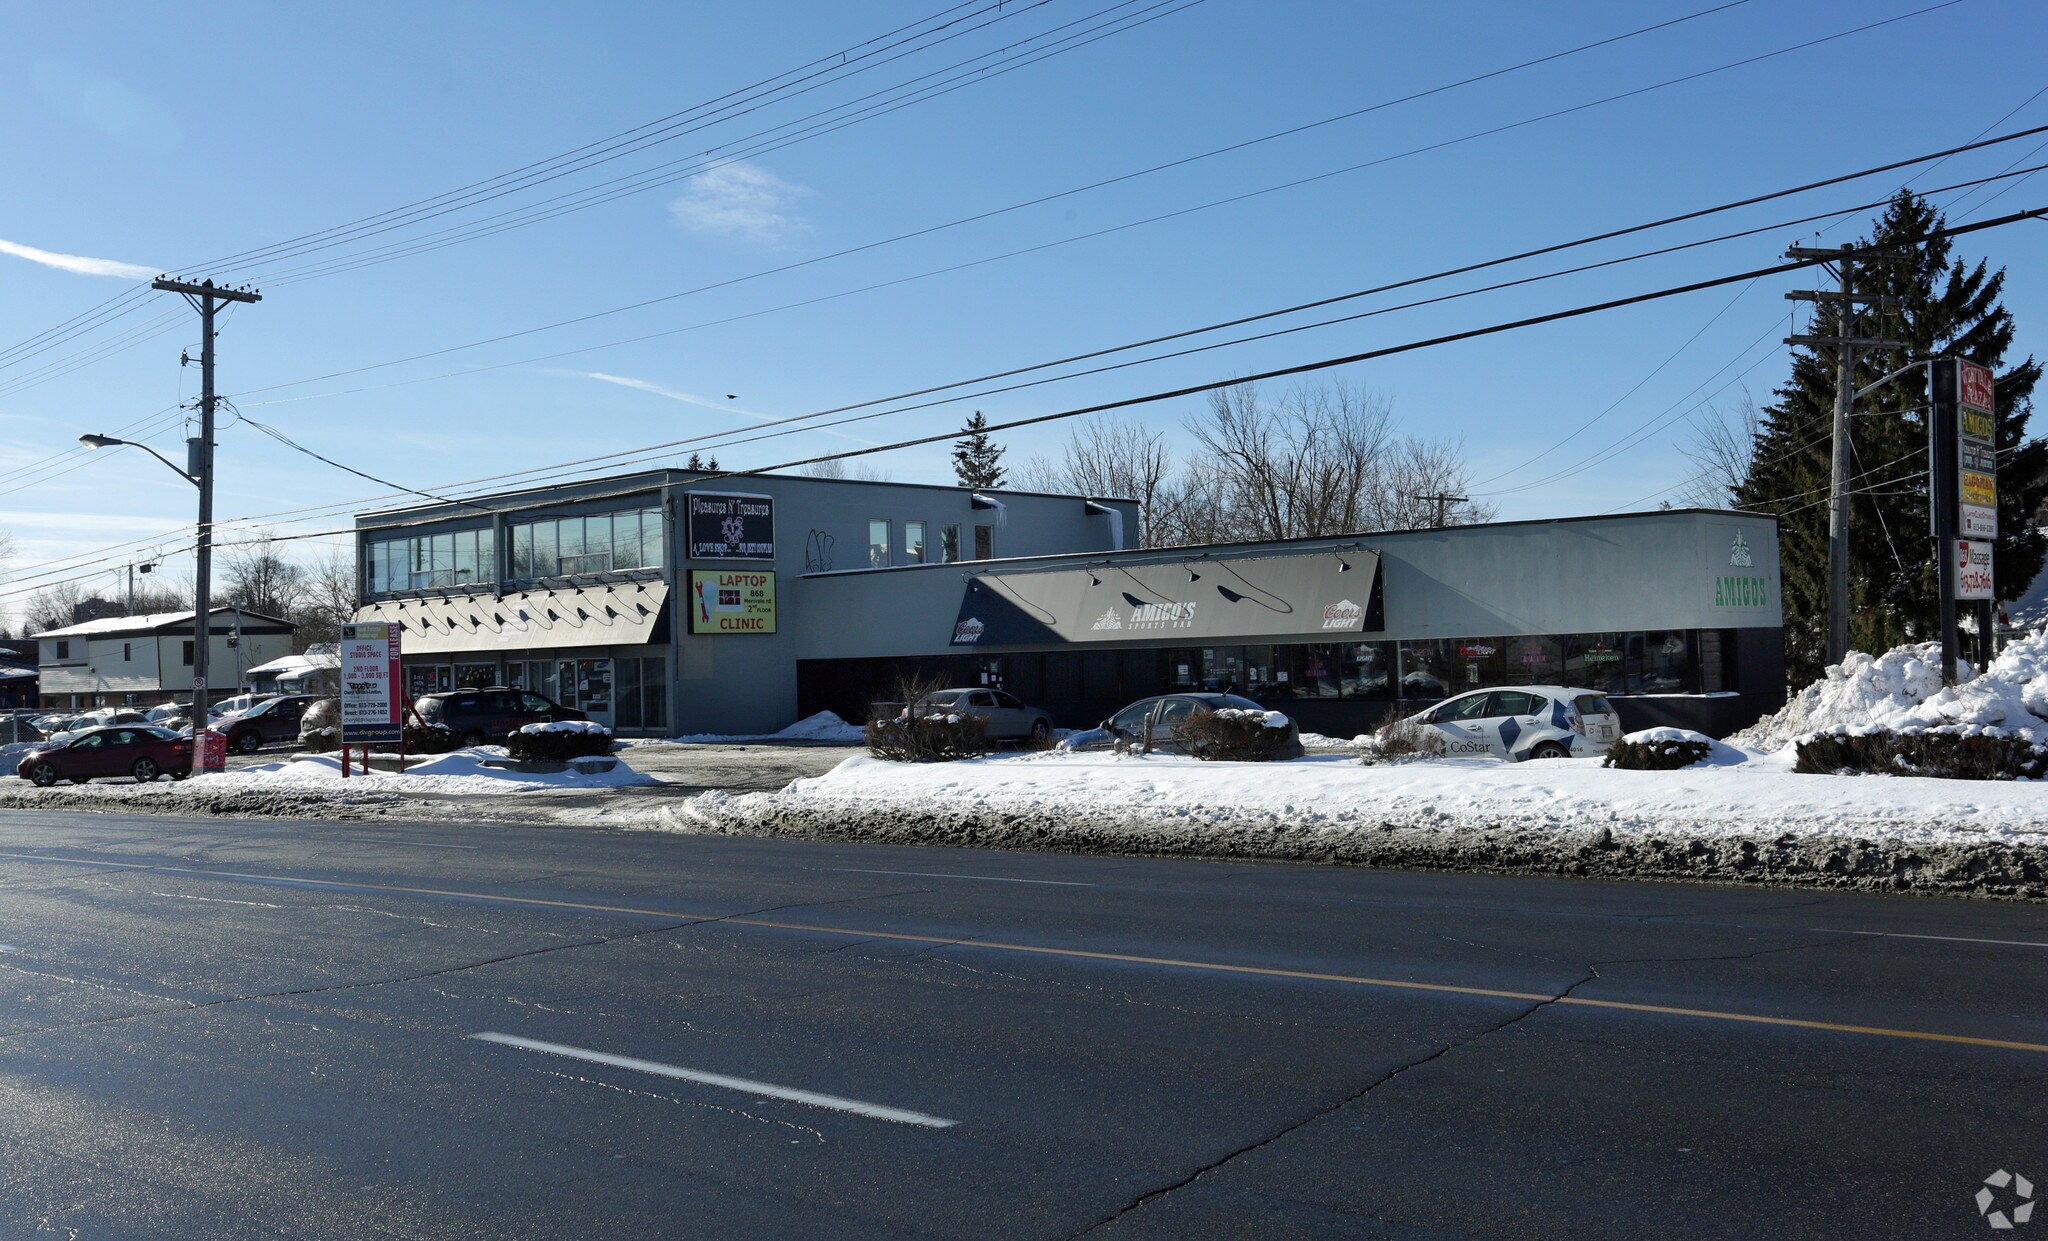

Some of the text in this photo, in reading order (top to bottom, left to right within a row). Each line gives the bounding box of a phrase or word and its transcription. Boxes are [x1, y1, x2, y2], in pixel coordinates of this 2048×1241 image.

[693, 498, 727, 515] Pleasures
[736, 499, 770, 516] Treasures
[699, 543, 714, 552] LOVE
[1969, 549, 1990, 570] Massage
[719, 575, 767, 587] LAPTOP
[1715, 576, 1767, 606] AMIGOS
[1130, 602, 1197, 622] AMIGO'S
[1322, 603, 1362, 621] Coors
[720, 618, 764, 630] CLINIC
[957, 621, 984, 635] Coors
[1128, 622, 1165, 630] SPORTS
[1322, 618, 1358, 629] LIGHT
[390, 624, 399, 660] FOR LEASE
[953, 633, 980, 643] LIGHT
[1584, 653, 1619, 662] Heineken
[1450, 741, 1491, 753] CoStar
